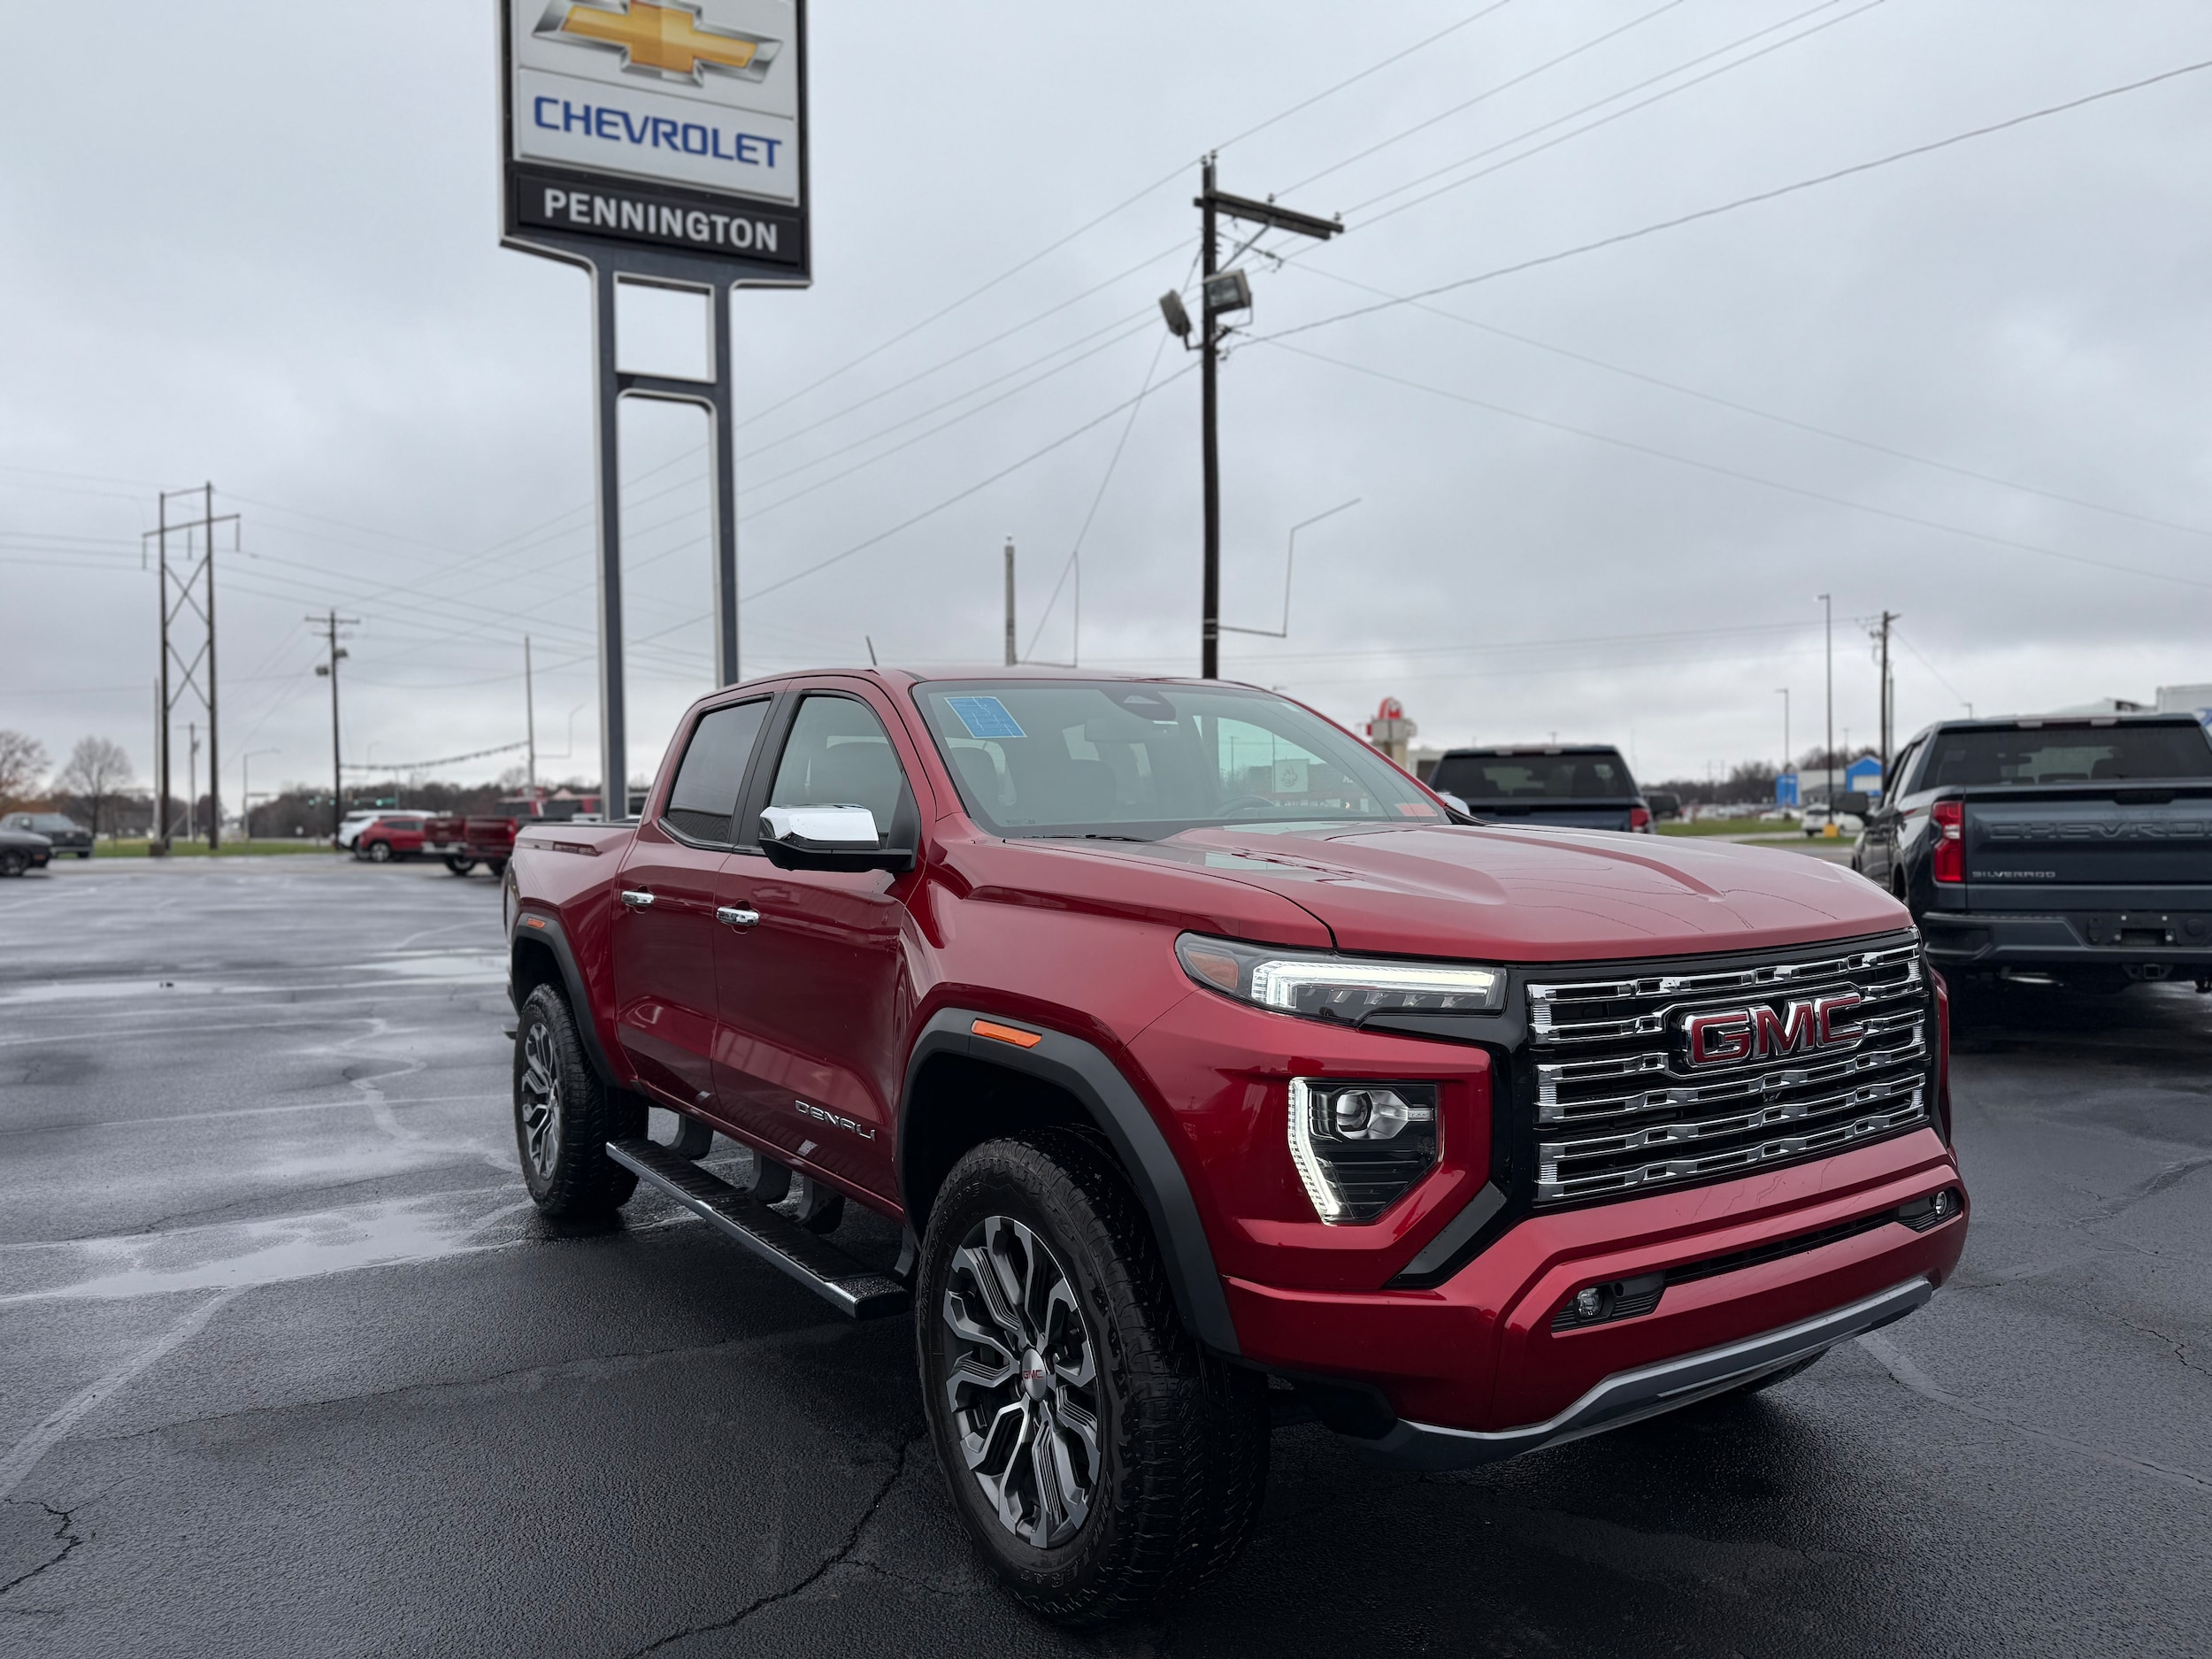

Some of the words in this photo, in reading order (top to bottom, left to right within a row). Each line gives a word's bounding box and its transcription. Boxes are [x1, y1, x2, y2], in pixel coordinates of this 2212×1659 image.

[534, 95, 783, 168] CHEVROLET
[544, 188, 779, 252] PENNINGTON
[1990, 820, 2212, 840] CHEVRO
[1684, 992, 1864, 1069] GMC
[795, 1100, 876, 1141] DENALI
[1023, 1370, 1045, 1379] GMC
